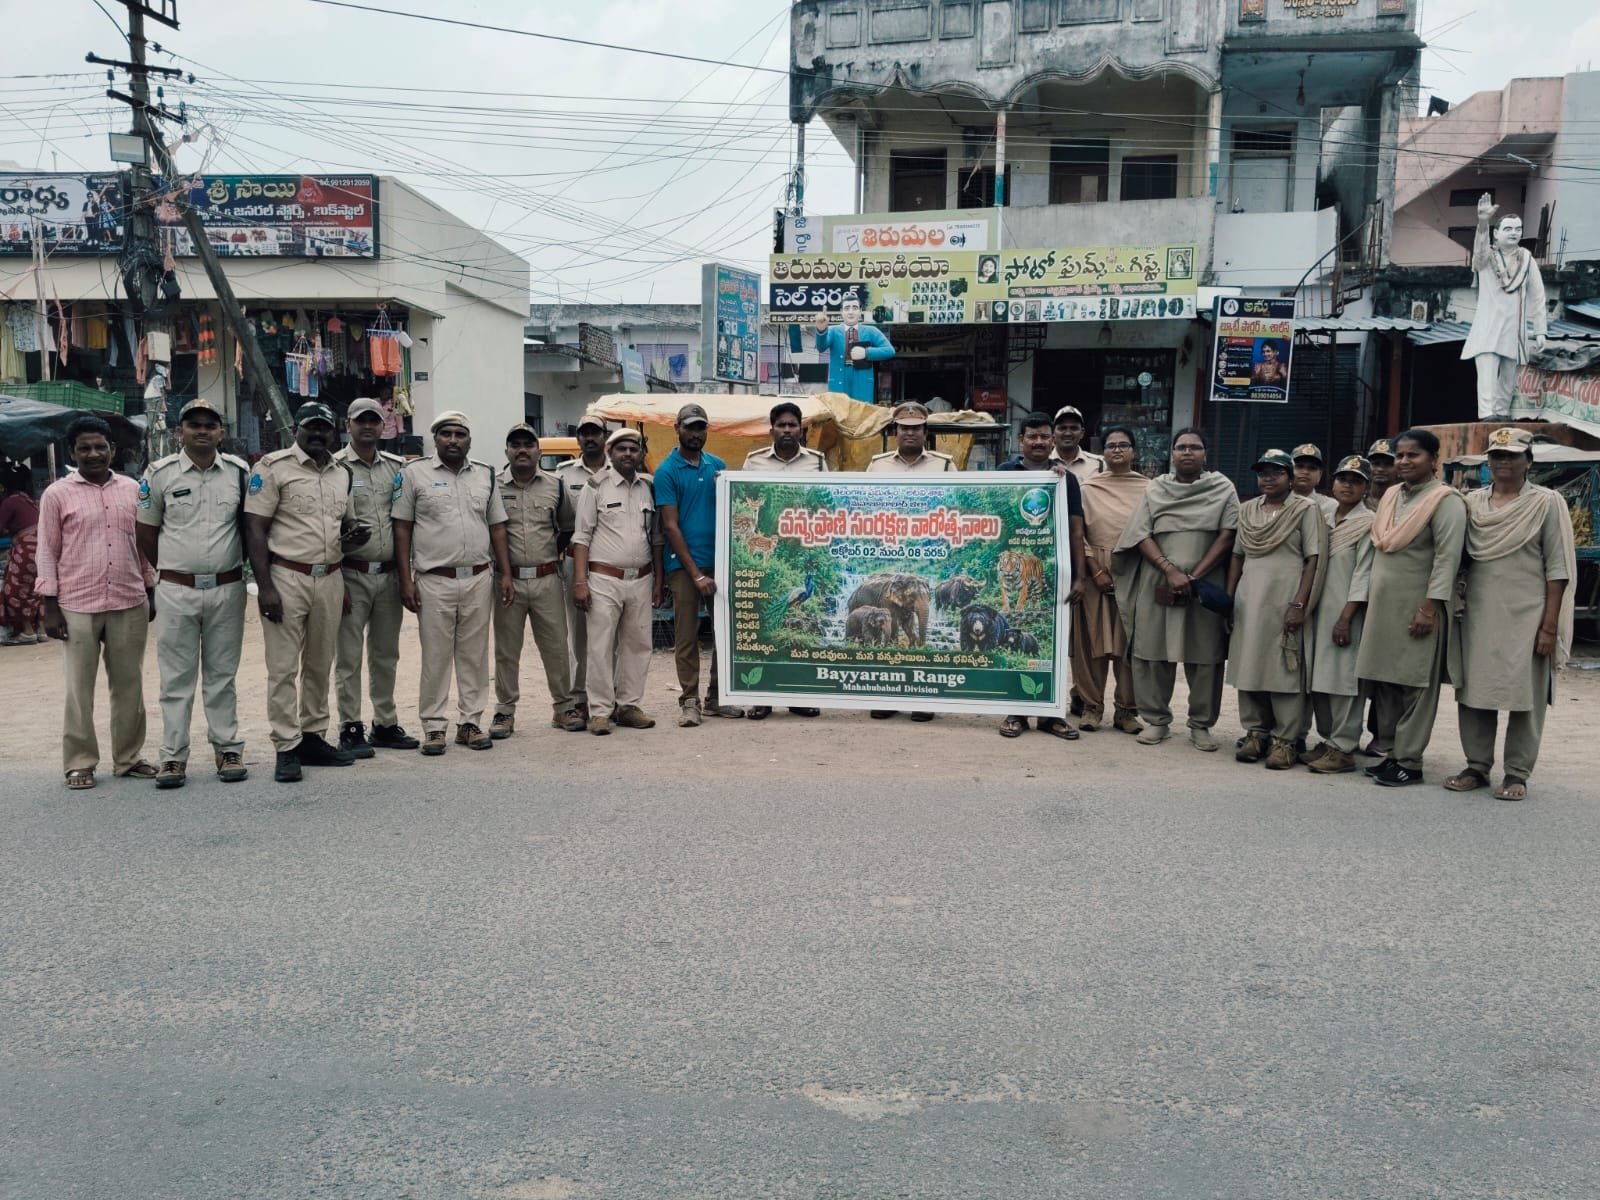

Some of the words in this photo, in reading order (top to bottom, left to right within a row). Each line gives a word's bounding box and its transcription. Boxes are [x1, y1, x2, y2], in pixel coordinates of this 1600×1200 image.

[207, 179, 230, 204] శ్రీ
[234, 179, 297, 200] సాయి
[234, 204, 274, 216] జనరల్
[862, 225, 945, 248] తిరుమల
[773, 258, 853, 280] తిరుమల
[858, 254, 950, 288] స్టూడియో
[1005, 251, 1055, 285] ఫోటో
[1115, 264, 1125, 273] &
[775, 285, 809, 307] సెల్
[779, 509, 847, 545] వన్యప్రాణి
[850, 511, 908, 545] సంరక్షణ
[910, 507, 999, 545] వారోత్సవాలు
[863, 547, 876, 556] 02
[880, 546, 905, 557] నుండి
[908, 548, 920, 557] 08
[924, 548, 946, 557] వరకు
[790, 649, 809, 658] మన
[856, 651, 873, 660] మన
[933, 653, 950, 663] మన
[816, 667, 906, 683] Bayyaram
[912, 670, 966, 687] Range
[842, 683, 901, 692] Mahabubabad
[904, 685, 938, 694] Division
